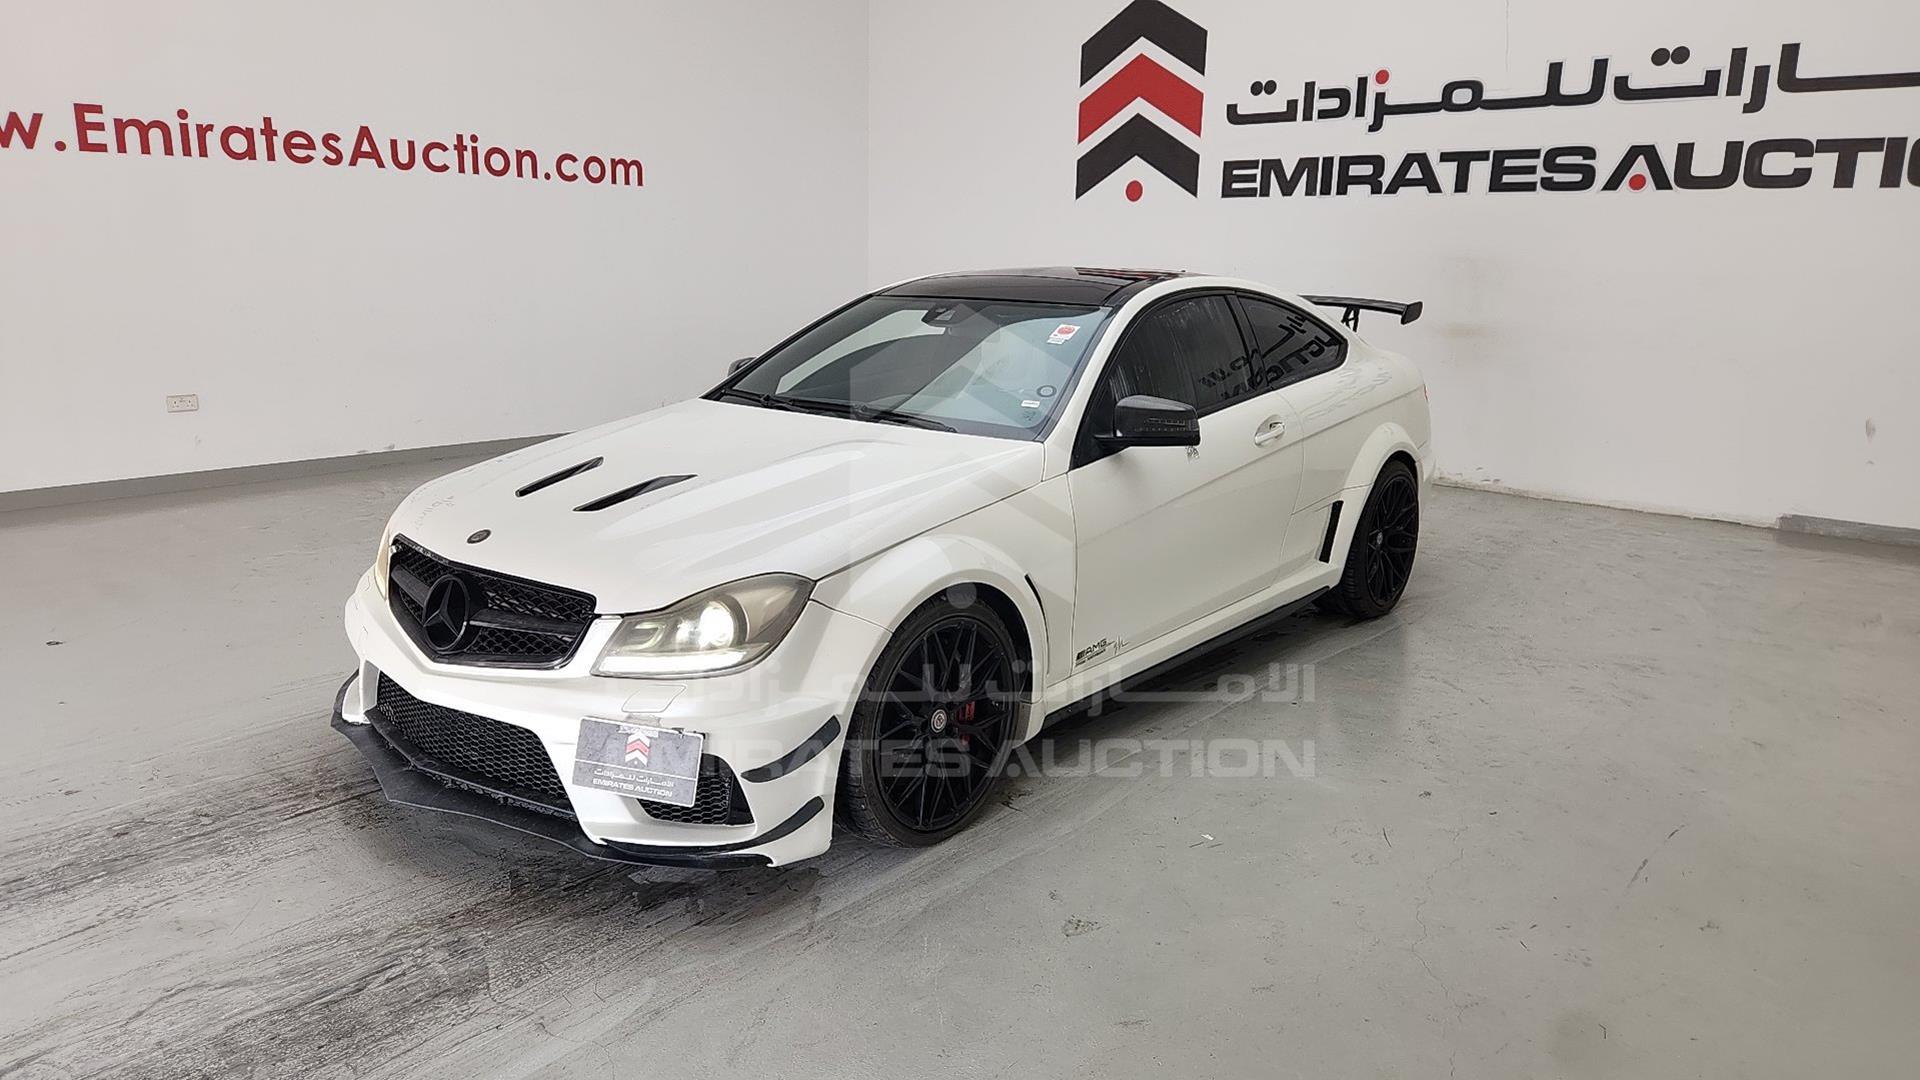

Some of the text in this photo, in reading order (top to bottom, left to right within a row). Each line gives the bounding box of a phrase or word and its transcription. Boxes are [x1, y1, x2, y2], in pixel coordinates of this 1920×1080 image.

[1226, 58, 1609, 133] للمزادات
[1221, 137, 1920, 198] EMIRATES AUCTI
[592, 778, 673, 798] EMIRATES AUCTION
